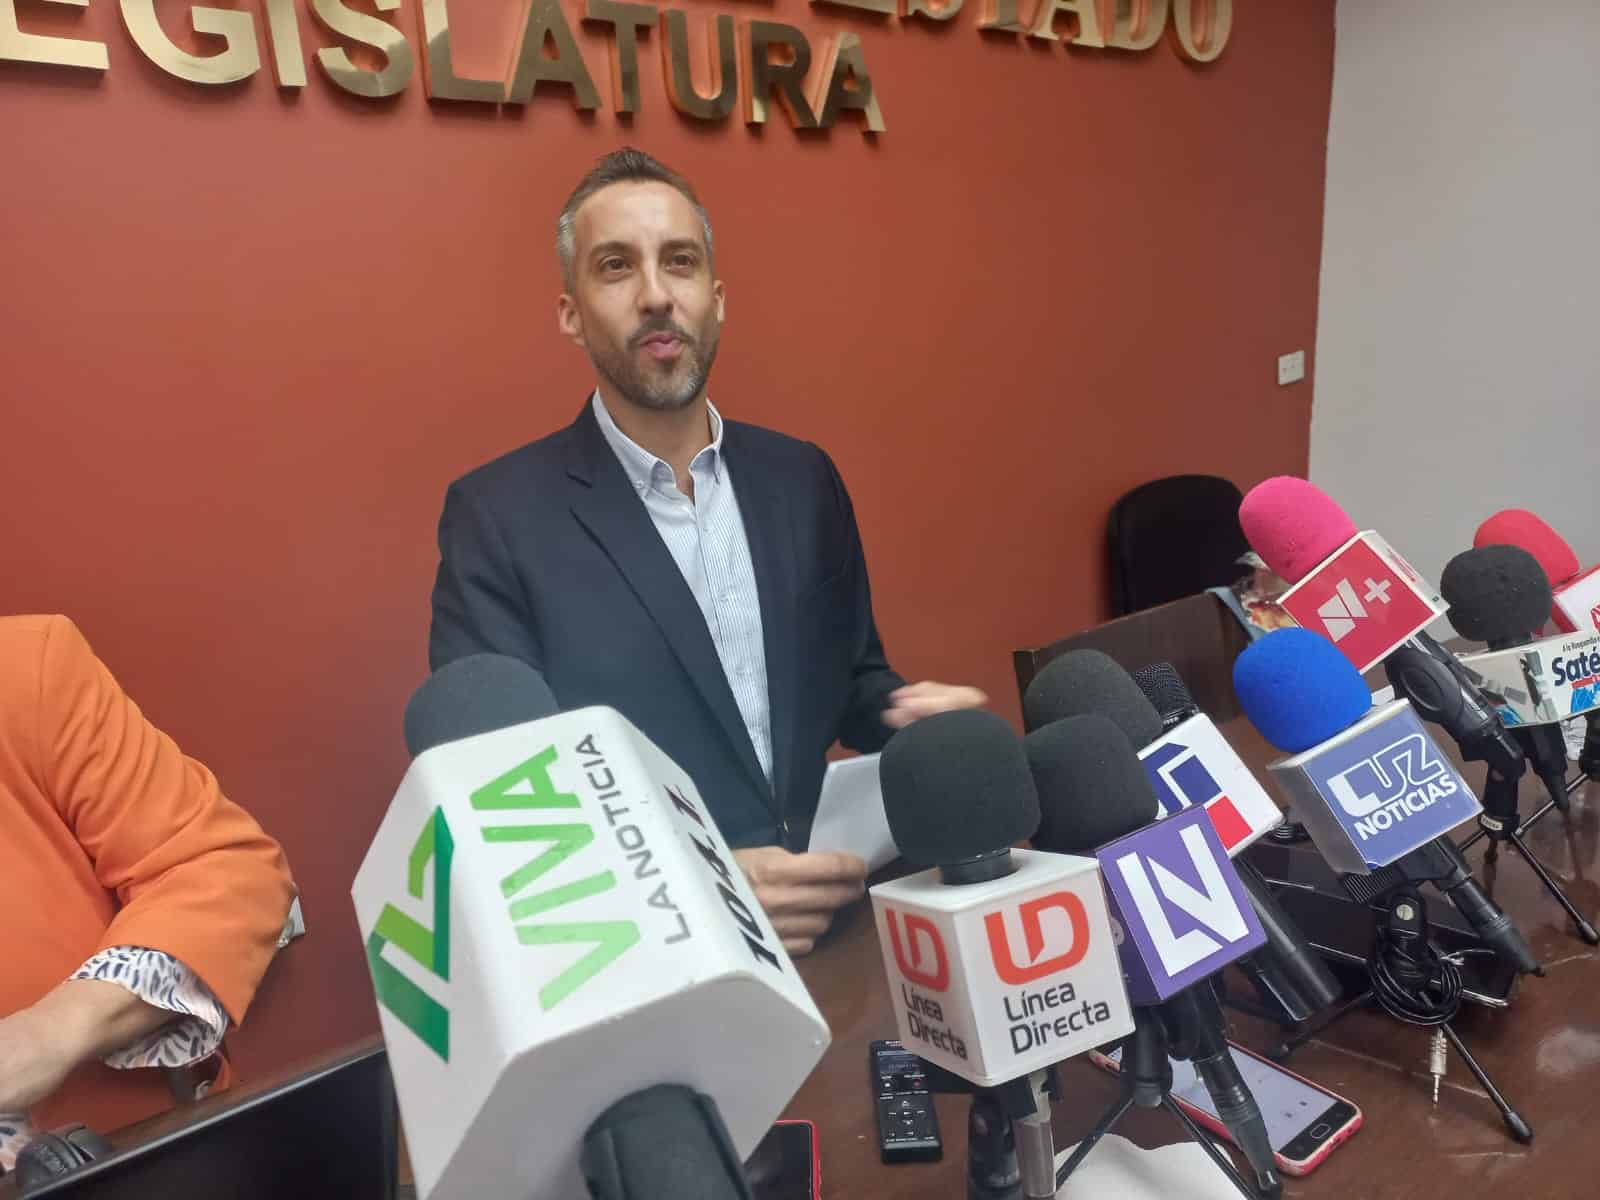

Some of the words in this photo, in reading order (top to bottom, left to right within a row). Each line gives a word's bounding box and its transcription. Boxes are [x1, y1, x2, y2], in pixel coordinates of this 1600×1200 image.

[575, 734, 662, 880] NOTICIA
[1326, 733, 1446, 817] LUZ
[1353, 774, 1458, 841] NOTICIAS
[470, 744, 642, 1011] VIVA
[1116, 823, 1250, 978] LN
[647, 881, 692, 944] LA
[902, 984, 944, 1023] Línea
[1004, 982, 1076, 1022] Línea
[1010, 1000, 1111, 1056] Directa
[907, 1011, 968, 1061] Directa
